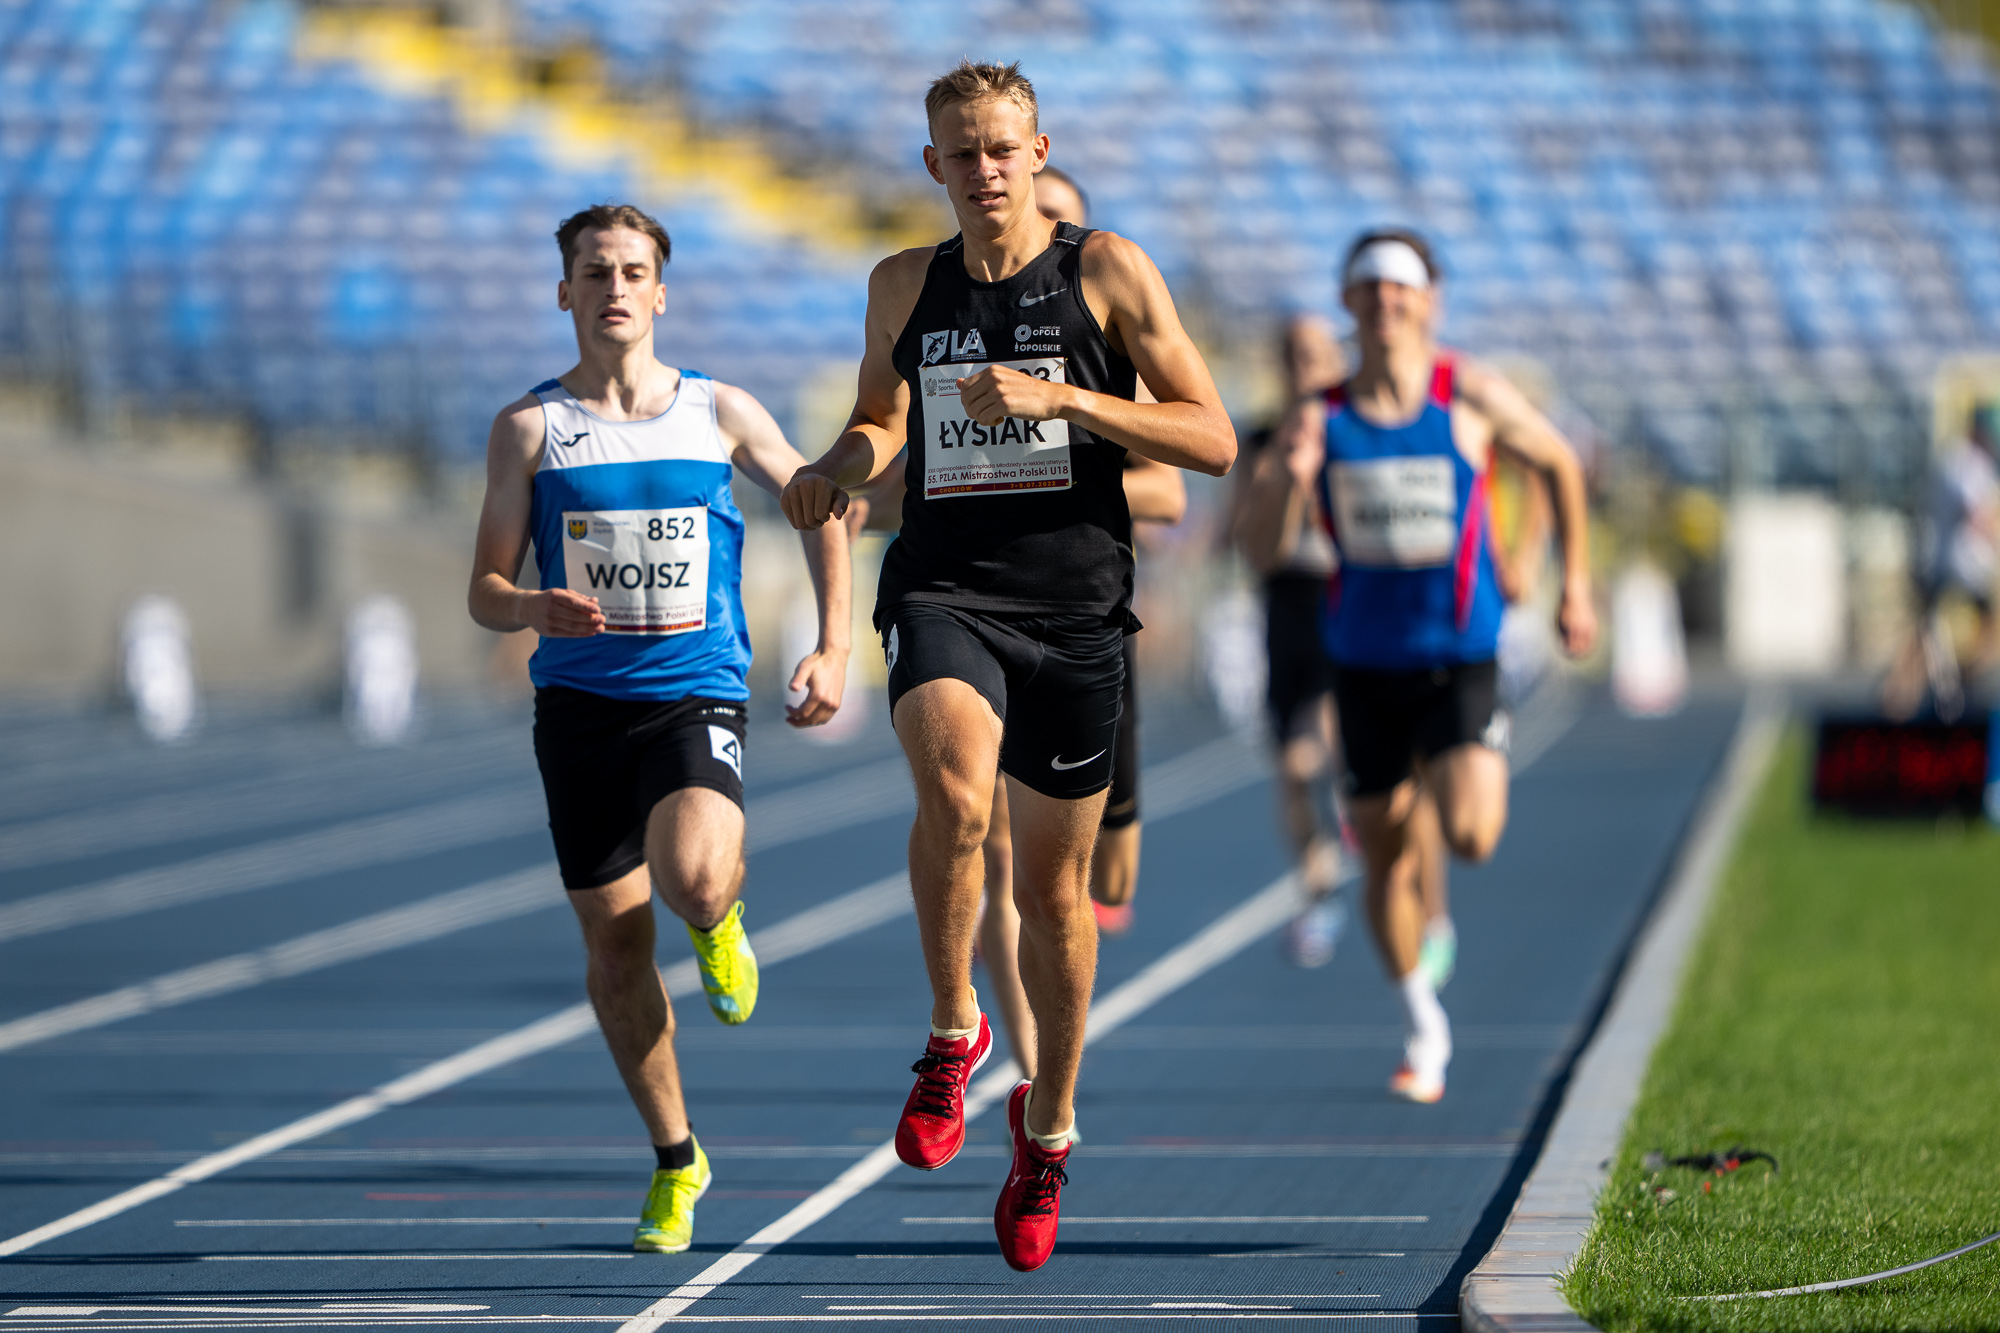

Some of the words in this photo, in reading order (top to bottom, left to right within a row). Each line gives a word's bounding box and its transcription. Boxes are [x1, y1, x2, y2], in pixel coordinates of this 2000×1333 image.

[1020, 343, 1061, 352] OPOLSKIE
[939, 416, 1046, 449] ŁYSIAK
[927, 474, 938, 484] 55.
[939, 472, 958, 482] PZLA
[960, 469, 1016, 481] Mistrzostwa
[1019, 466, 1048, 478] Polski
[1050, 465, 1069, 476] U18
[939, 485, 973, 494] CHORZÓW
[1010, 480, 1056, 490] 7-9.07.2022
[647, 516, 695, 541] 852
[585, 562, 690, 590] WOJSZ
[609, 612, 663, 621] Mistrzostwa
[666, 611, 689, 620] Polski
[690, 608, 704, 617] U18
